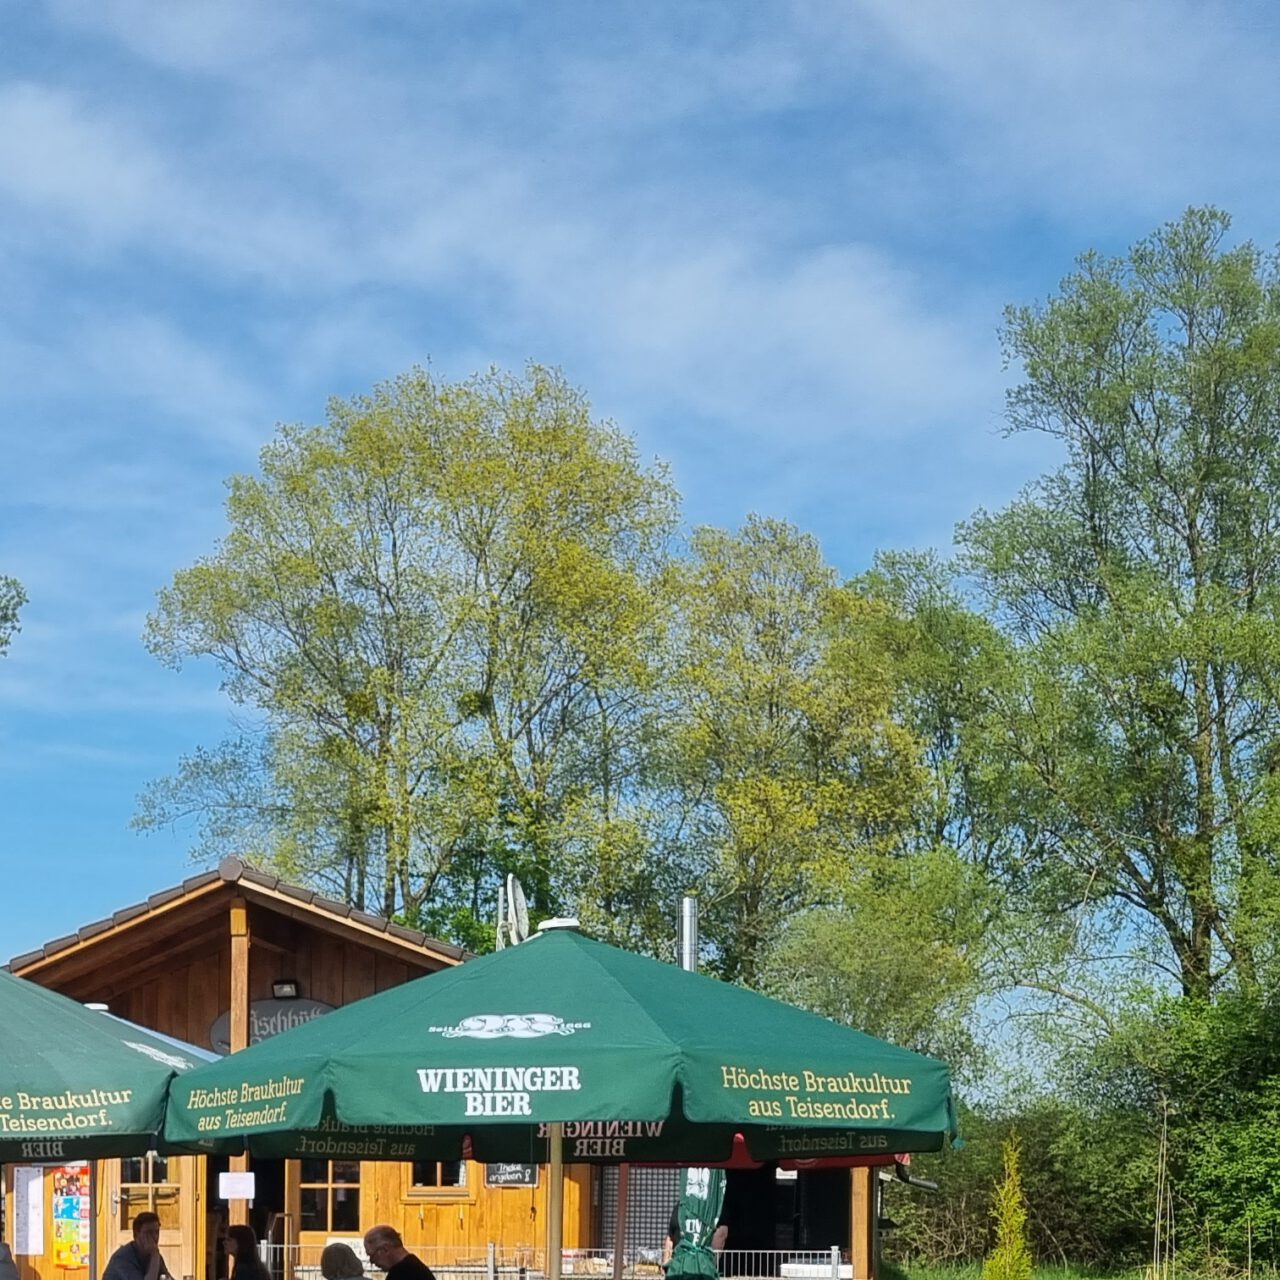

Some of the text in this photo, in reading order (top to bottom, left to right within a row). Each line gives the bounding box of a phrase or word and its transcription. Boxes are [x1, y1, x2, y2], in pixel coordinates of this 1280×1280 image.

[417, 1067, 581, 1092] WIENINGER
[721, 1066, 911, 1094] Höchste Braukultur
[17, 1089, 132, 1109] Braukultur
[187, 1076, 304, 1109] Höchste Braukultur
[465, 1092, 532, 1116] BIER
[198, 1102, 287, 1131] aus Teisendorf.
[749, 1097, 895, 1119] aus Teisendorf.
